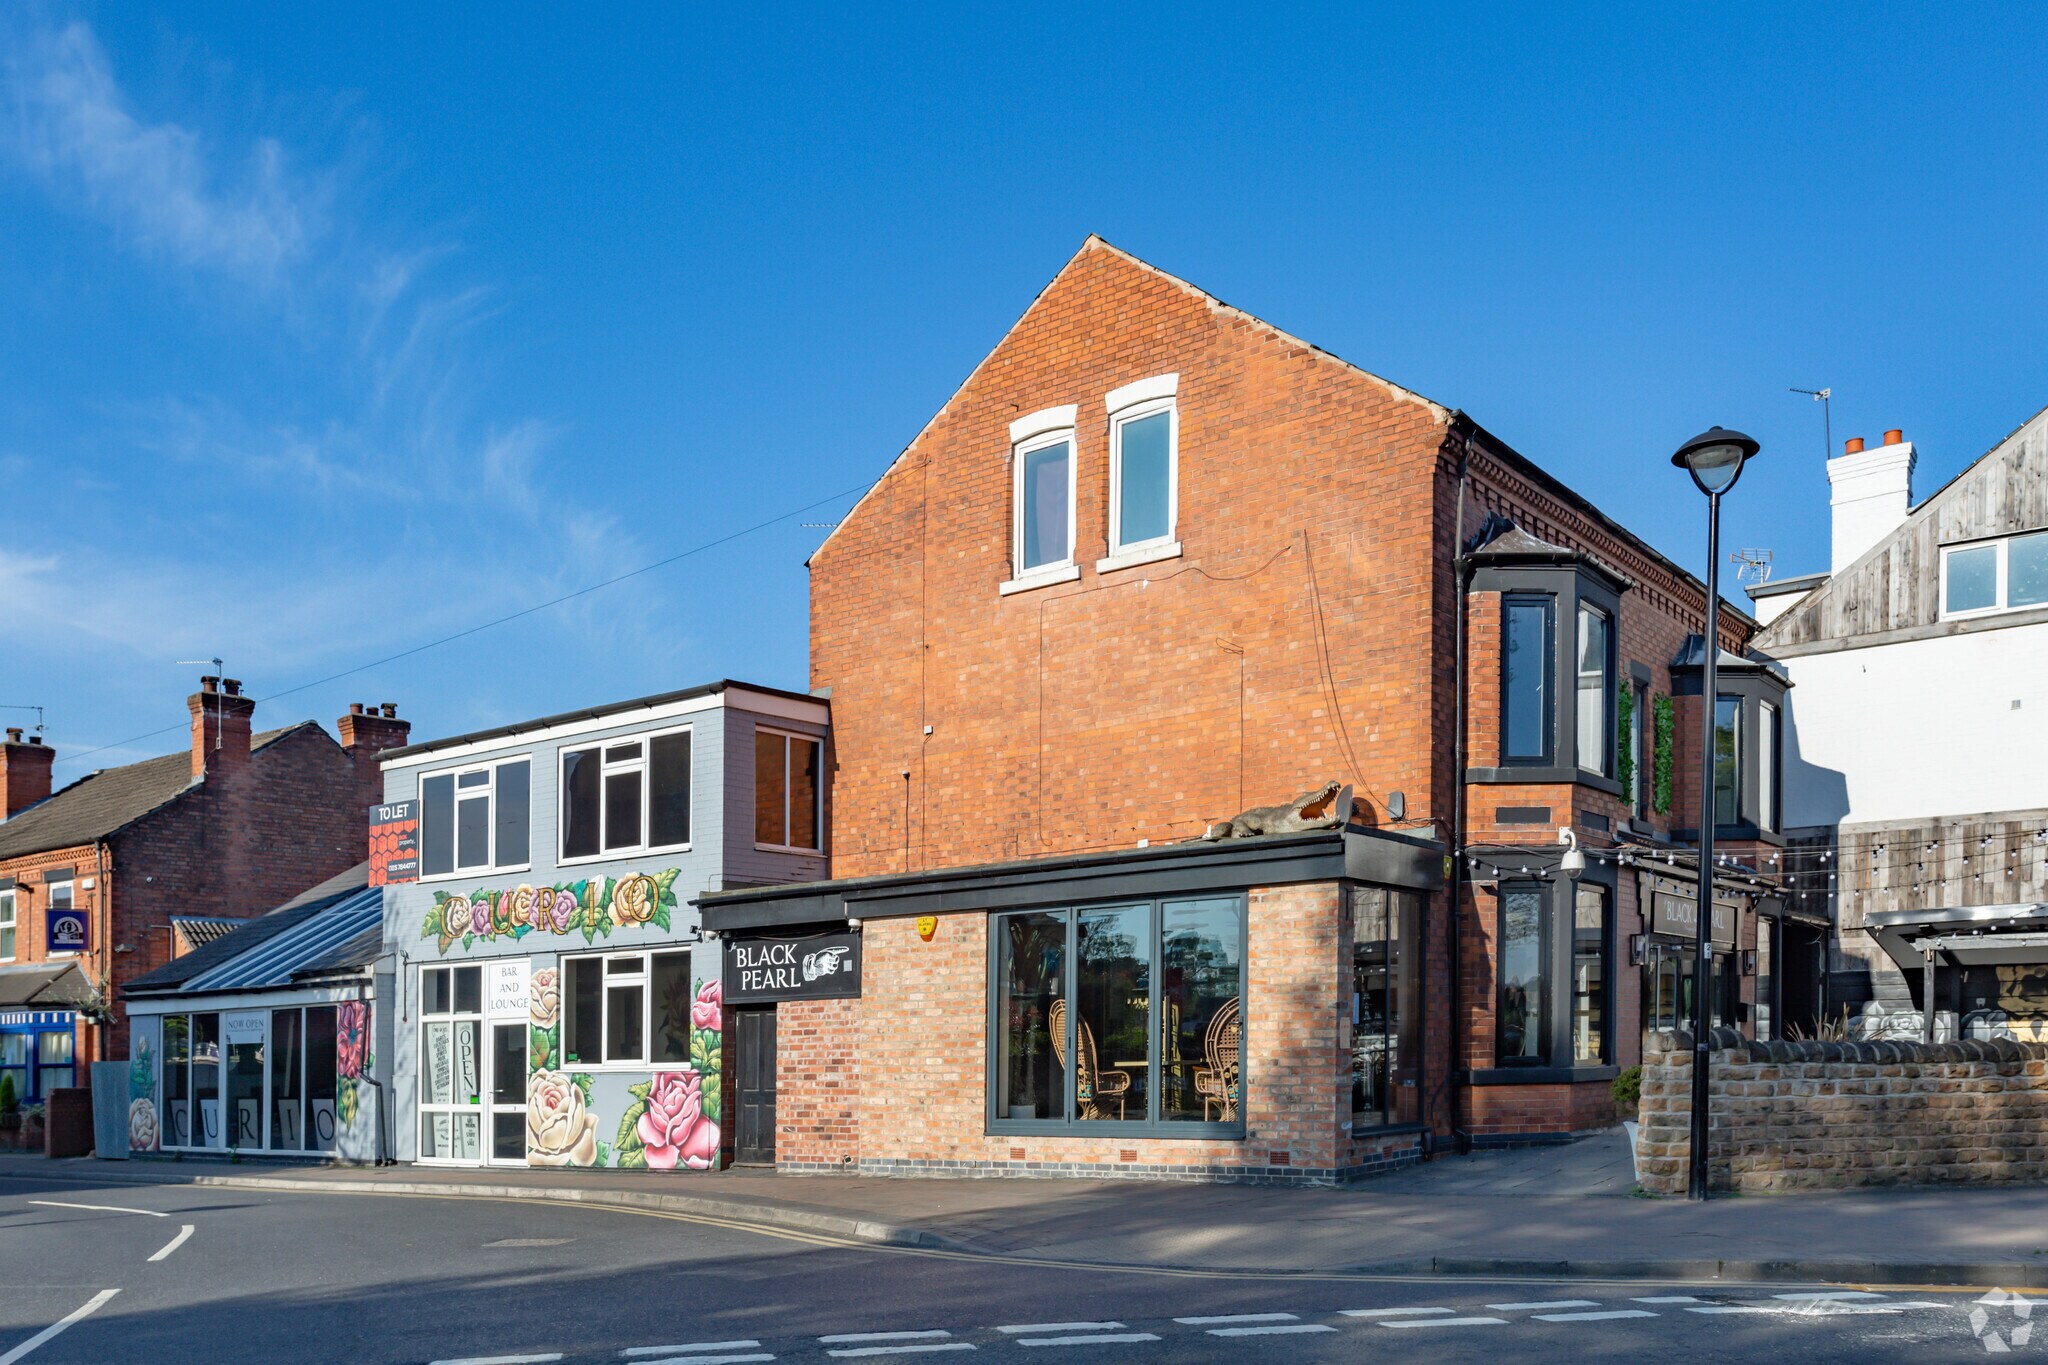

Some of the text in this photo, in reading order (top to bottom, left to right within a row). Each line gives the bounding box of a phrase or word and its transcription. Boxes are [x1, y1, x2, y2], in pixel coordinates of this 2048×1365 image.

[379, 803, 409, 821] TO LET
[440, 875, 659, 938] CURIO
[1667, 900, 1693, 924] BLACK
[736, 943, 798, 968] BLACK
[501, 966, 518, 977] BAR
[741, 967, 802, 990] PEARL
[500, 982, 520, 993] AND
[490, 997, 529, 1010] LOUNGE
[228, 1018, 264, 1029] NOW OPEN
[460, 1029, 474, 1091] OPEN
[175, 1108, 335, 1141] CURIO
